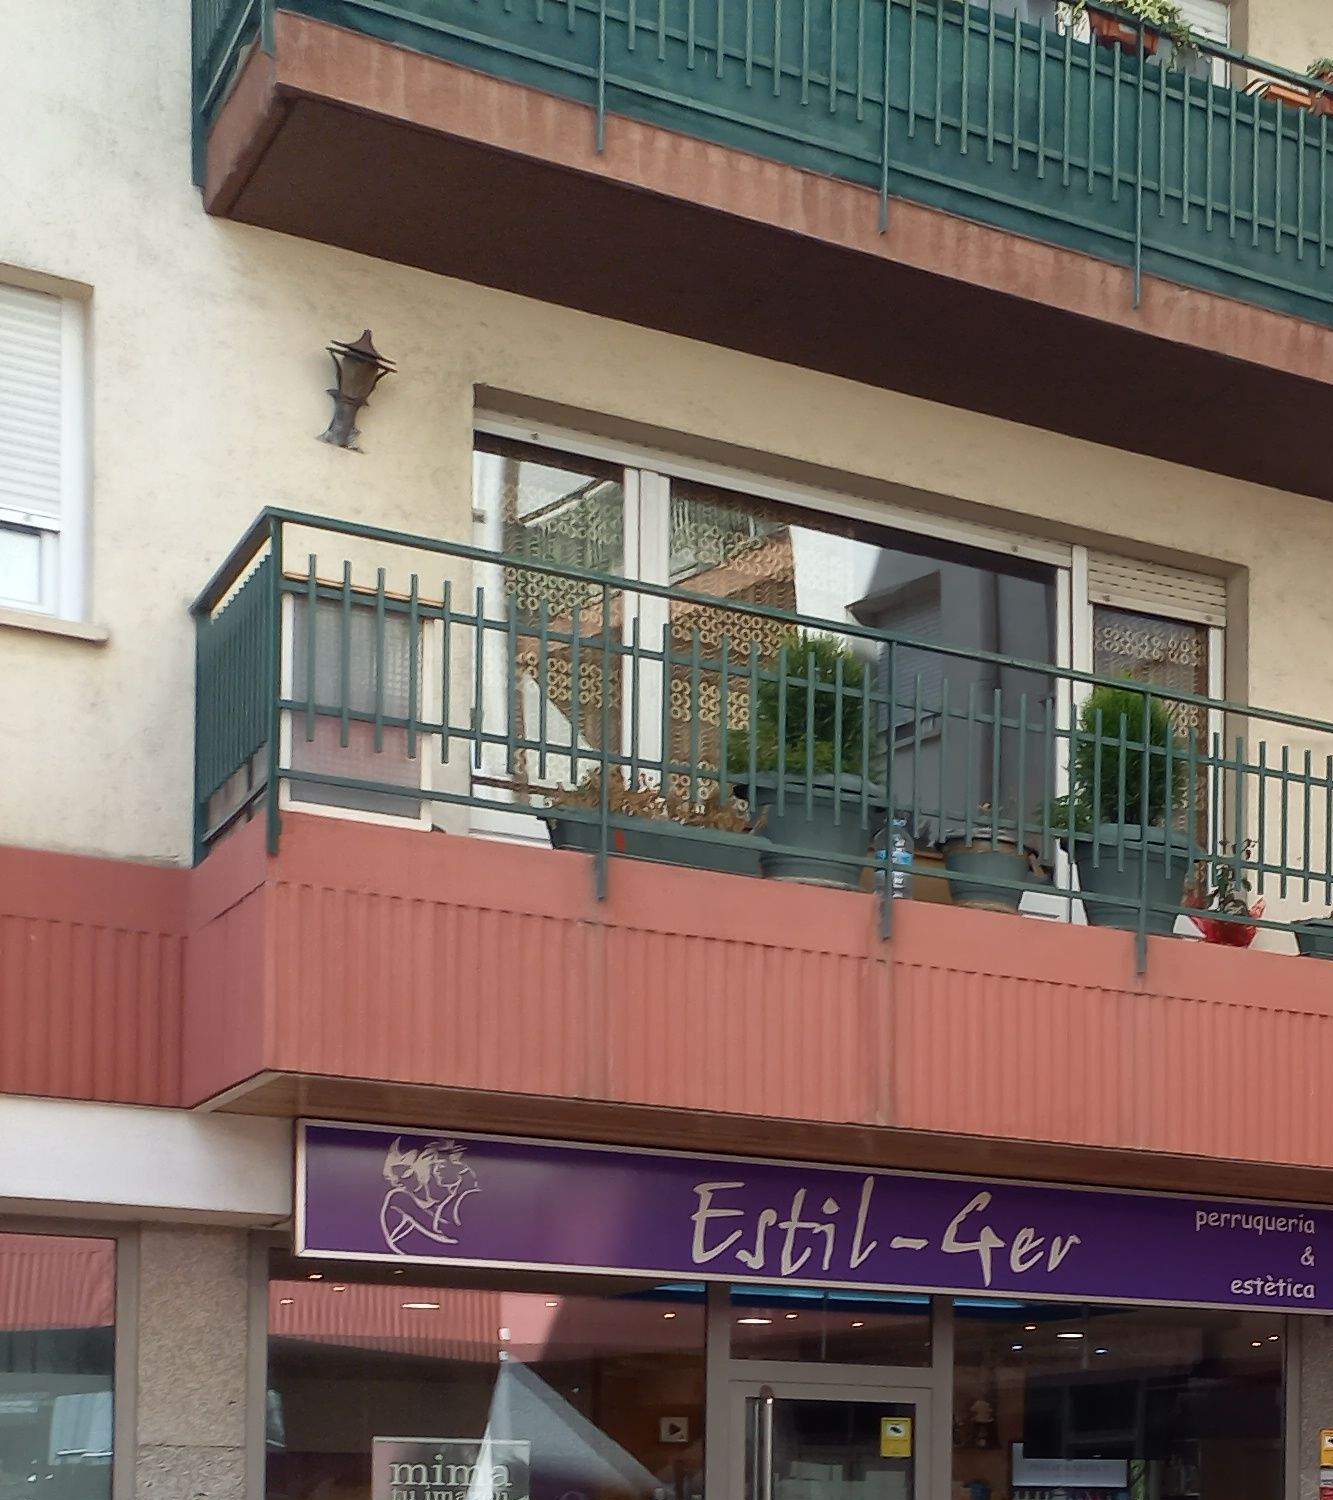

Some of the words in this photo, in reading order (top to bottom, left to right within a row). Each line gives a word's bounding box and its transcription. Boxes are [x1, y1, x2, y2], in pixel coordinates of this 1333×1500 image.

[692, 1175, 1082, 1288] Estil-Ger
[1300, 1245, 1315, 1267] &
[1230, 1274, 1316, 1299] estètica
[388, 1454, 513, 1487] mima
